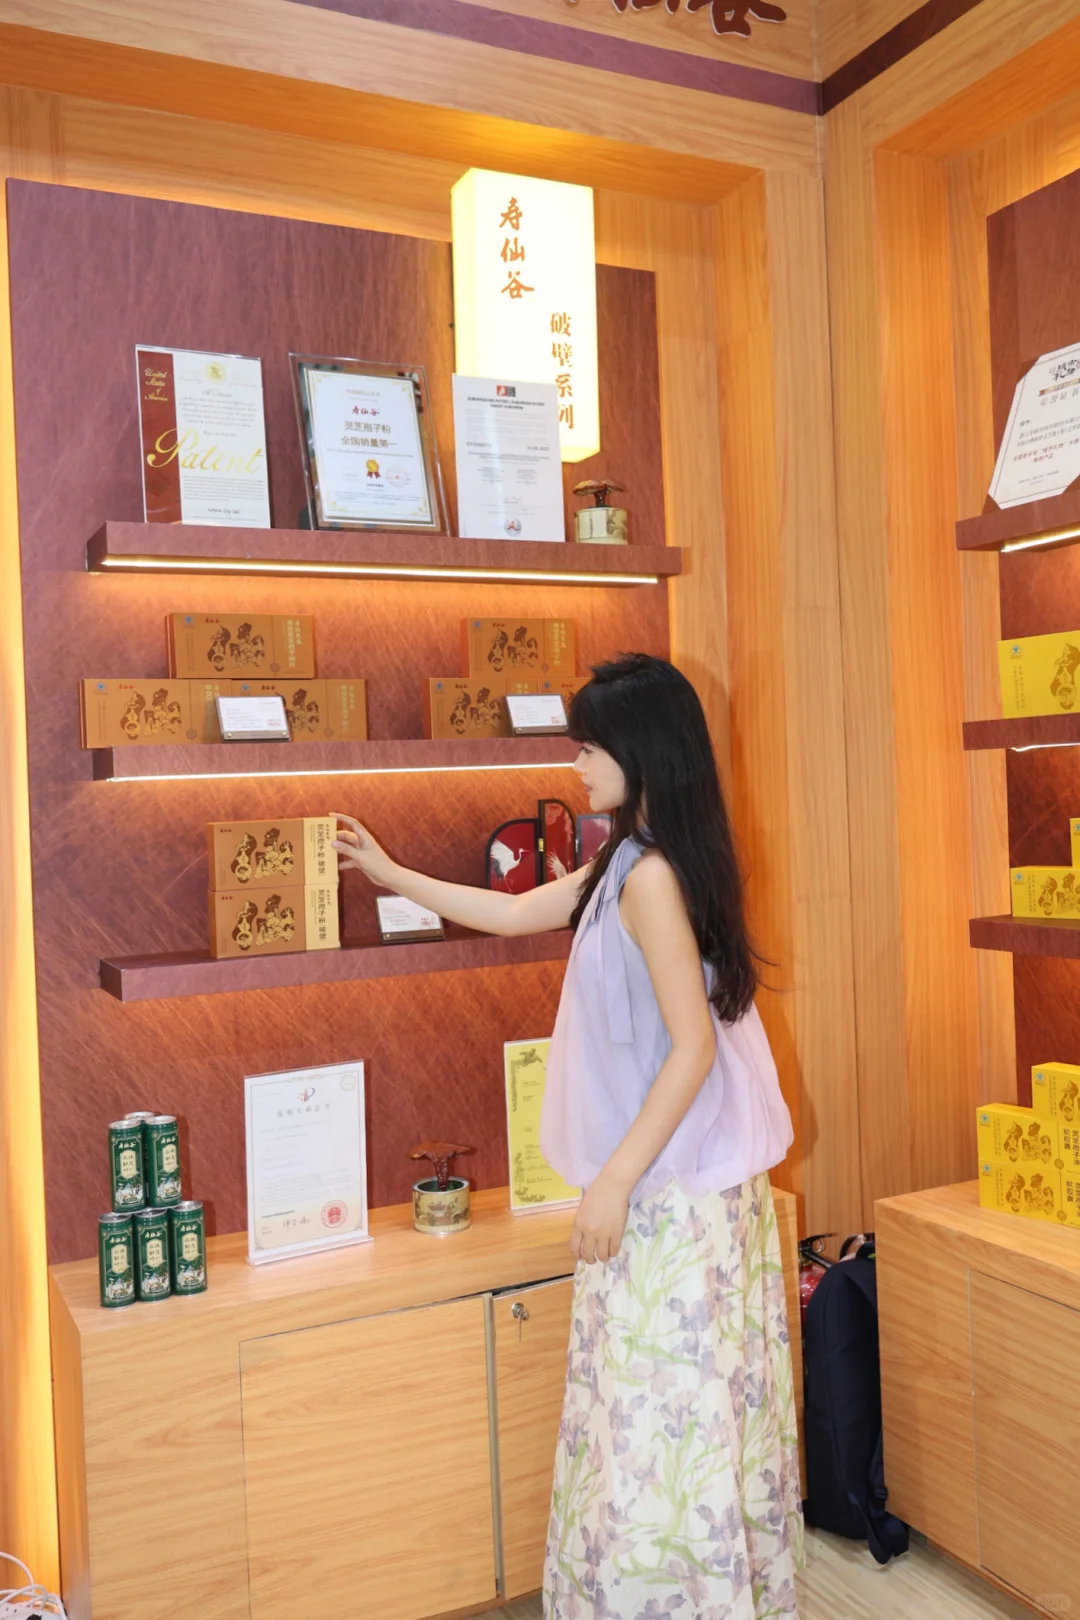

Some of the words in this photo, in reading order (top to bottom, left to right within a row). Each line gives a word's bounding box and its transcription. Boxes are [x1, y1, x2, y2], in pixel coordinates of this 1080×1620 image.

[499, 196, 535, 299] 寿仙谷
[550, 312, 574, 430] 破壁系列
[147, 427, 263, 474] Patent
[341, 435, 398, 448] 全国销量第一
[344, 421, 391, 434] 灵芝孢子粉
